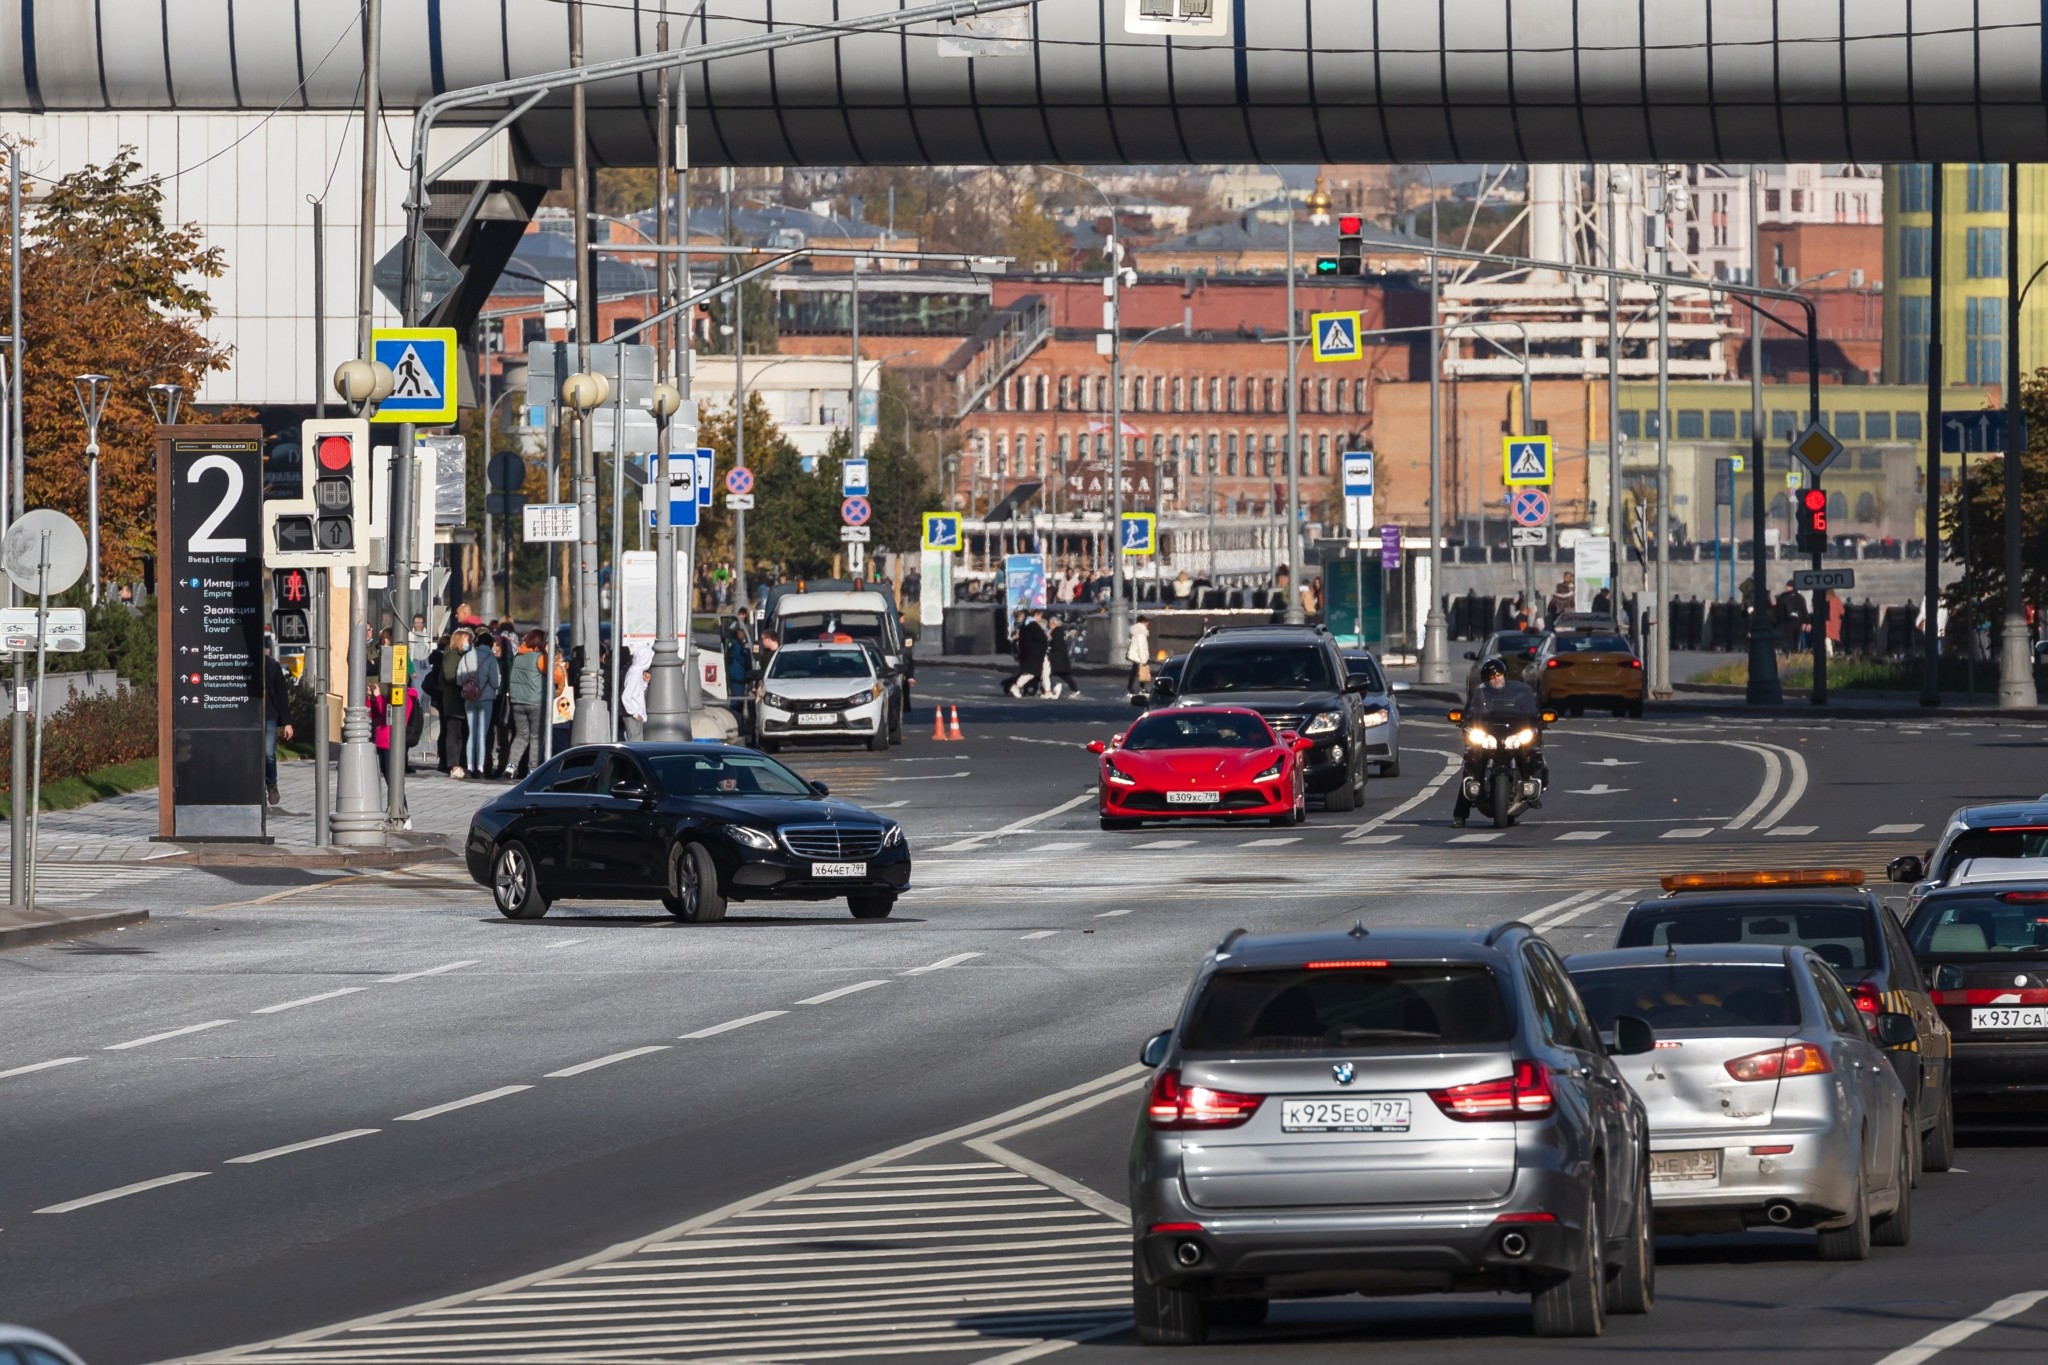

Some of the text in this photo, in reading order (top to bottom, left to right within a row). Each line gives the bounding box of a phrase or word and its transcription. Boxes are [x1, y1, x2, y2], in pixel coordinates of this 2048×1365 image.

[187, 454, 247, 553] 2
[1813, 512, 1826, 531] 16
[188, 555, 210, 563] Въезд
[215, 555, 246, 563] Entrance
[203, 578, 250, 590] Империя
[1803, 573, 1844, 586] СТОП
[203, 589, 232, 599] Empire
[203, 605, 256, 616] Эволюция
[203, 616, 242, 624] Evolution
[204, 625, 231, 633] Tower
[203, 652, 249, 661] «Багратион»
[203, 660, 255, 668] Bagration Bridge
[203, 673, 252, 681] Выставочная
[203, 681, 247, 689] Vistavochnaya
[203, 694, 249, 703] Экспоцентр
[203, 702, 239, 710] Expocentre
[851, 863, 864, 872] 799
[1978, 1010, 2042, 1026] К937СА
[1290, 1102, 1404, 1123] К925ЕО 797
